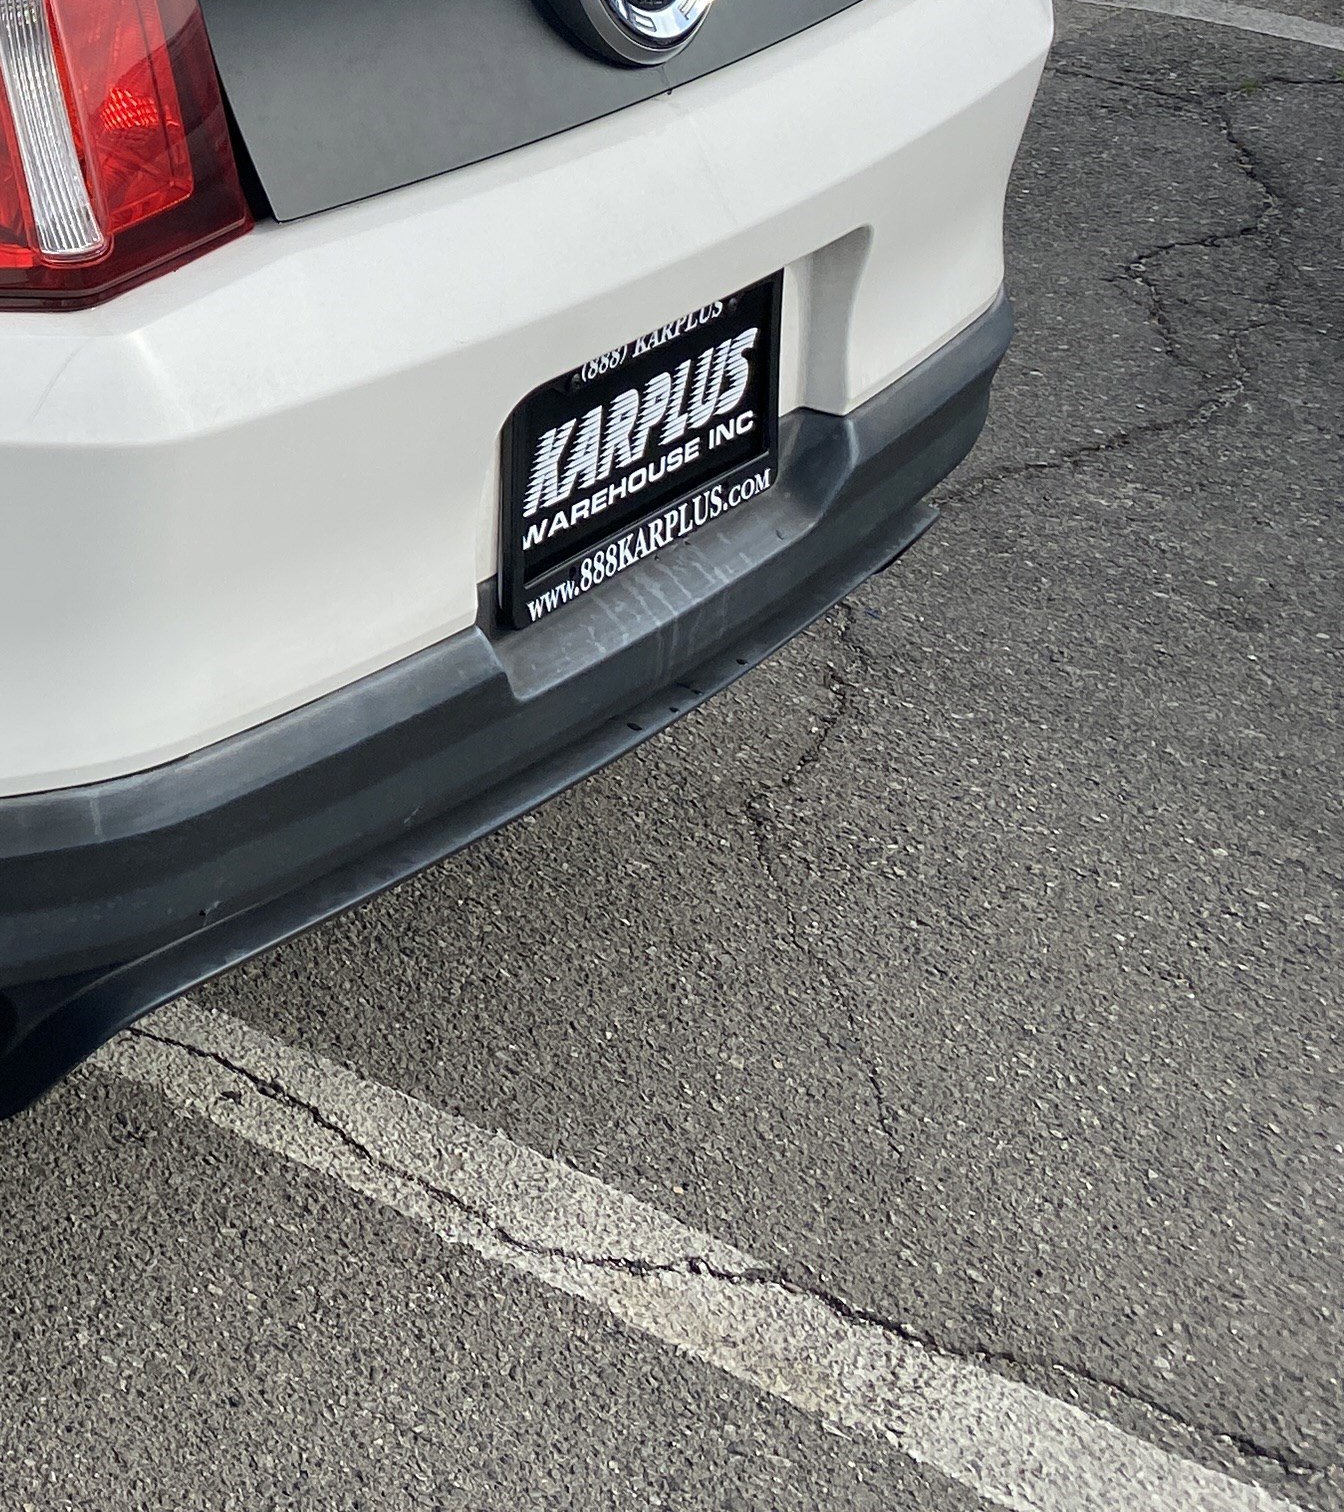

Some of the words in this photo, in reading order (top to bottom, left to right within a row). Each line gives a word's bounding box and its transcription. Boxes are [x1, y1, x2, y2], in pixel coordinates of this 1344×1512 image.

[522, 437, 701, 551] WAREHOUSE
[708, 410, 755, 450] INC
[523, 326, 759, 518] KARPLUS
